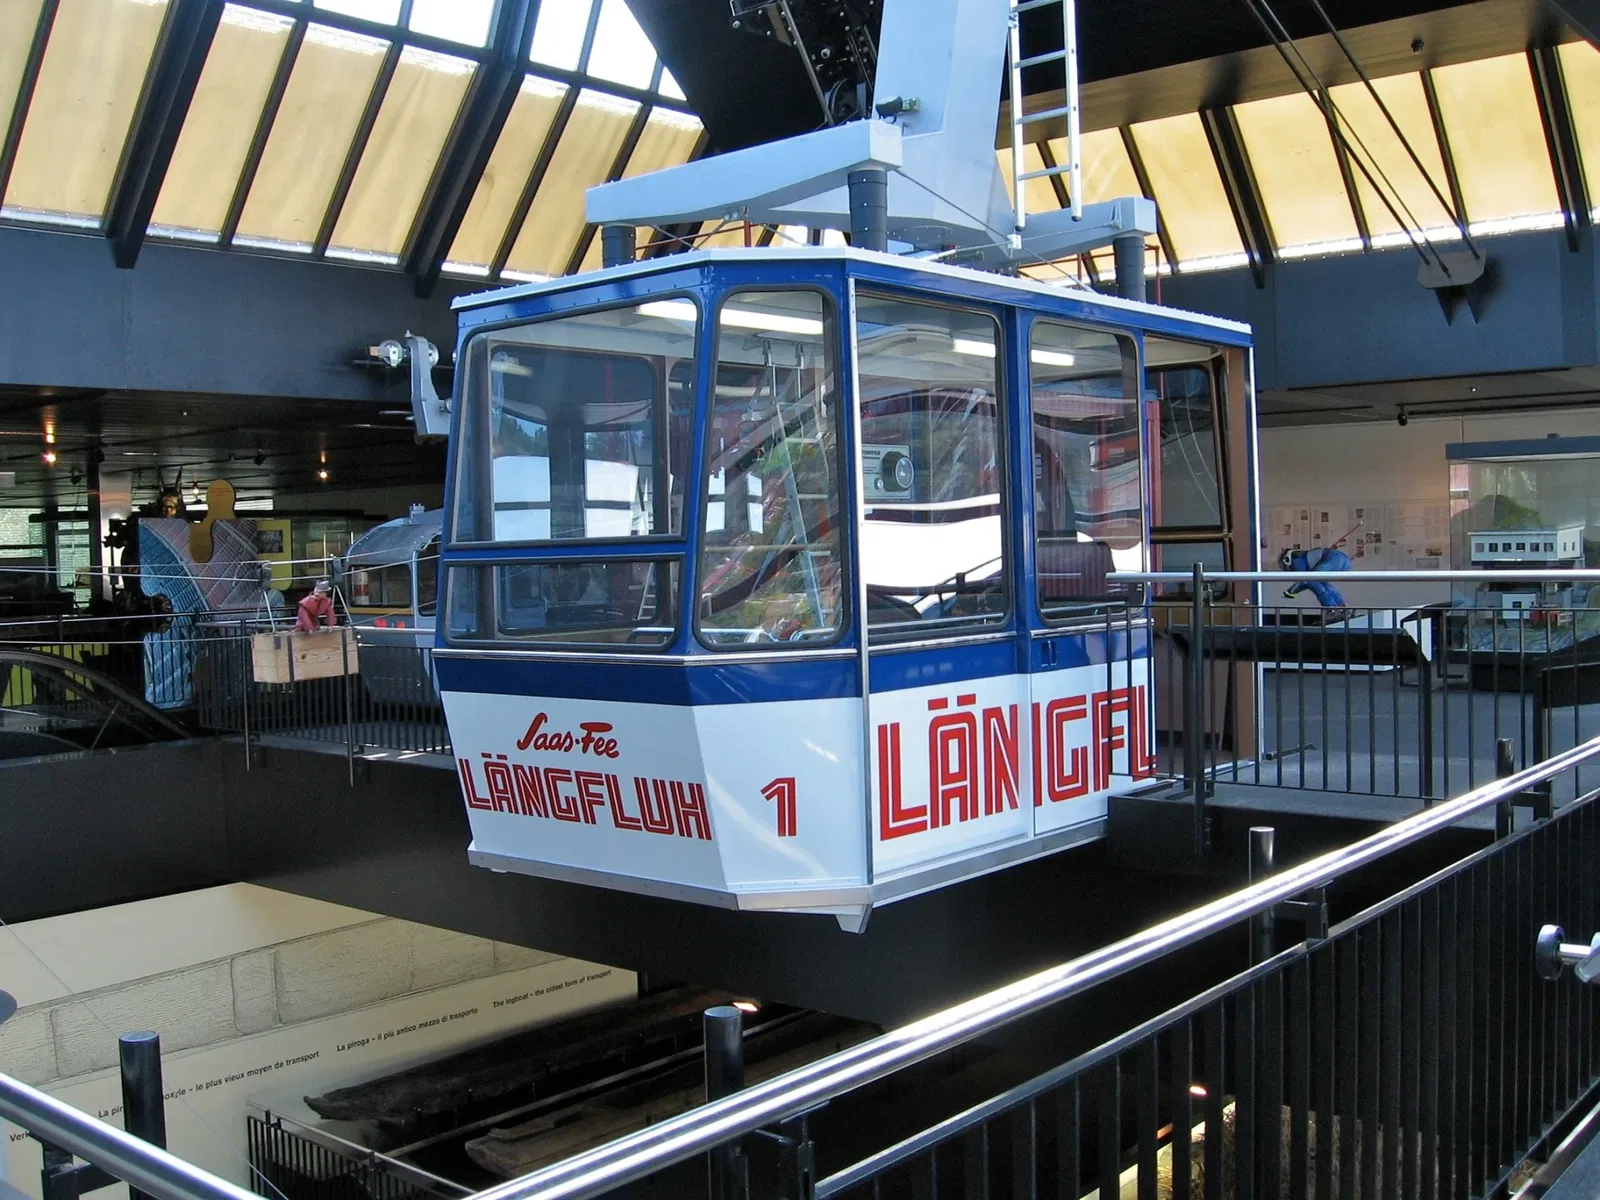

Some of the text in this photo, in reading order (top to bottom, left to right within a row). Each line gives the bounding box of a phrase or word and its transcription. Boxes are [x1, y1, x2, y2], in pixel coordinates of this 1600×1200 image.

[458, 752, 712, 841] LÄNGFLUH
[760, 776, 797, 838] 1
[579, 976, 586, 984] of
[336, 1043, 346, 1052] La
[347, 1038, 370, 1050] piroga
[377, 1033, 382, 1041] il
[396, 1024, 417, 1036] antico
[418, 1018, 440, 1029] mezzo
[441, 1015, 448, 1023] di
[448, 1007, 479, 1021] trasporto
[98, 1110, 109, 1118] La
[111, 1106, 124, 1116] pir
[163, 1088, 187, 1100] oxyle
[195, 1083, 204, 1092] le
[205, 1078, 223, 1090] plus
[224, 1071, 245, 1083] vieux
[246, 1064, 273, 1077] moyen
[274, 1060, 284, 1070] de
[285, 1051, 320, 1067] transport
